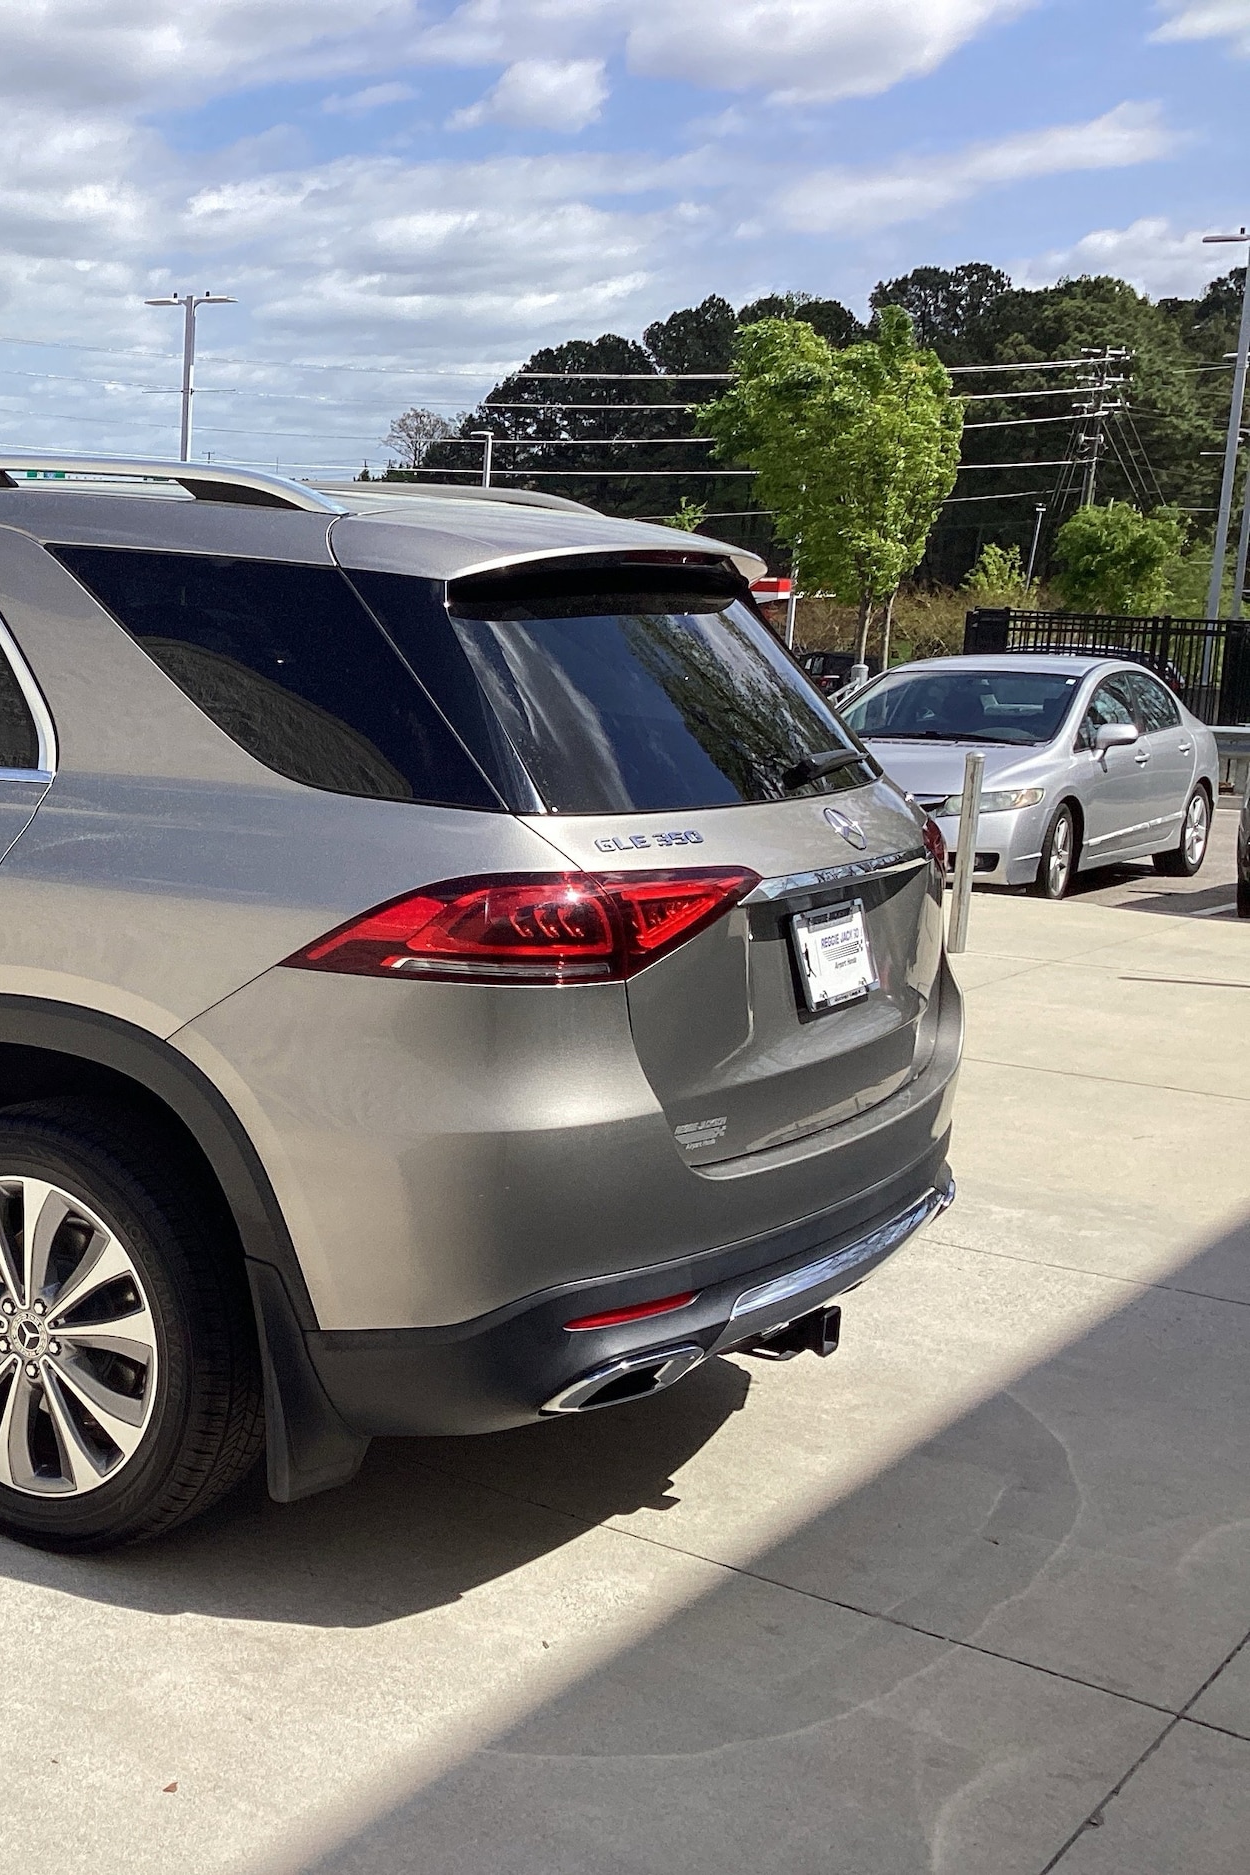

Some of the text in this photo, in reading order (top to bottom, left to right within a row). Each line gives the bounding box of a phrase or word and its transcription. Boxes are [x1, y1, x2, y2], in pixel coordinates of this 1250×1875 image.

[594, 830, 705, 853] GLE 350
[820, 933, 839, 950] REGGIE
